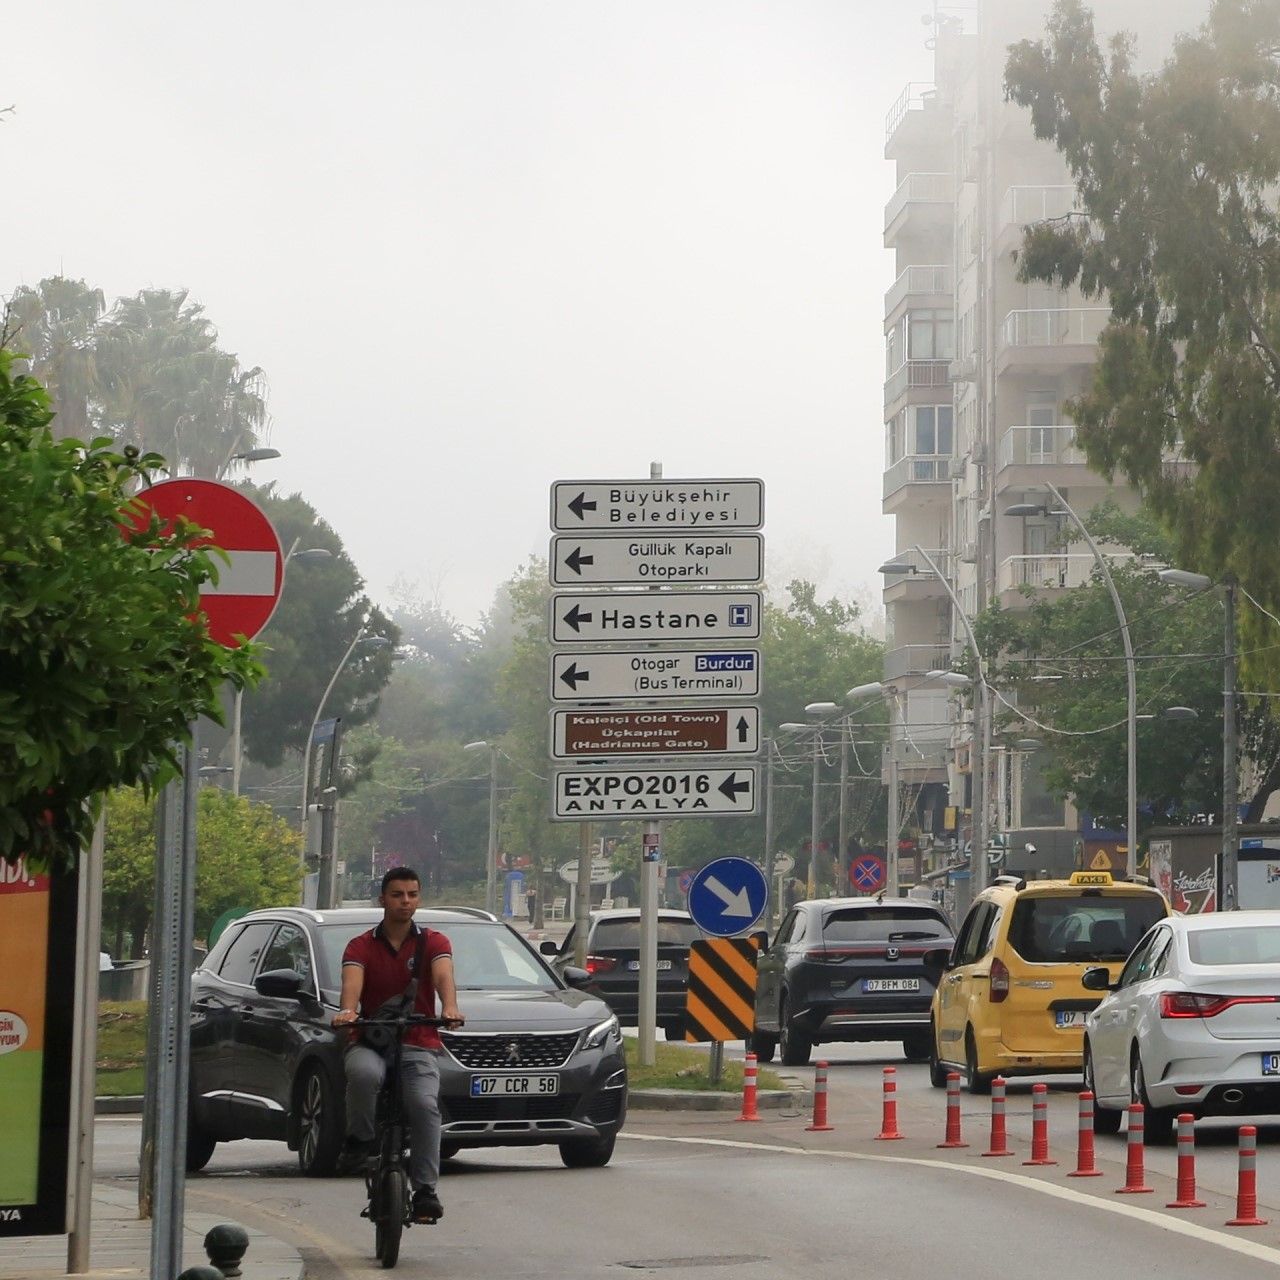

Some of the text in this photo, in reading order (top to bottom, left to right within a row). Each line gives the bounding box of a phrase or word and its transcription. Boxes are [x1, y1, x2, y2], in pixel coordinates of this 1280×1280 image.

[610, 489, 731, 507] Büyükşehir
[610, 508, 738, 524] Belediyesi
[628, 542, 732, 559] Güllük Kapalı
[638, 563, 709, 579] Otoparkı
[602, 608, 718, 630] Hastane
[630, 657, 752, 672] Otogar Burdur
[634, 675, 743, 691] (Bus Terminal)
[634, 715, 666, 725] (Old
[672, 714, 720, 723] Town)
[665, 739, 709, 749] Gate)
[563, 774, 710, 797] EXPO2016
[564, 797, 710, 812] ANTALYA
[1064, 1012, 1075, 1023] 07
[481, 1078, 555, 1093] 07 CCR 58
[0, 1209, 21, 1221] YA
